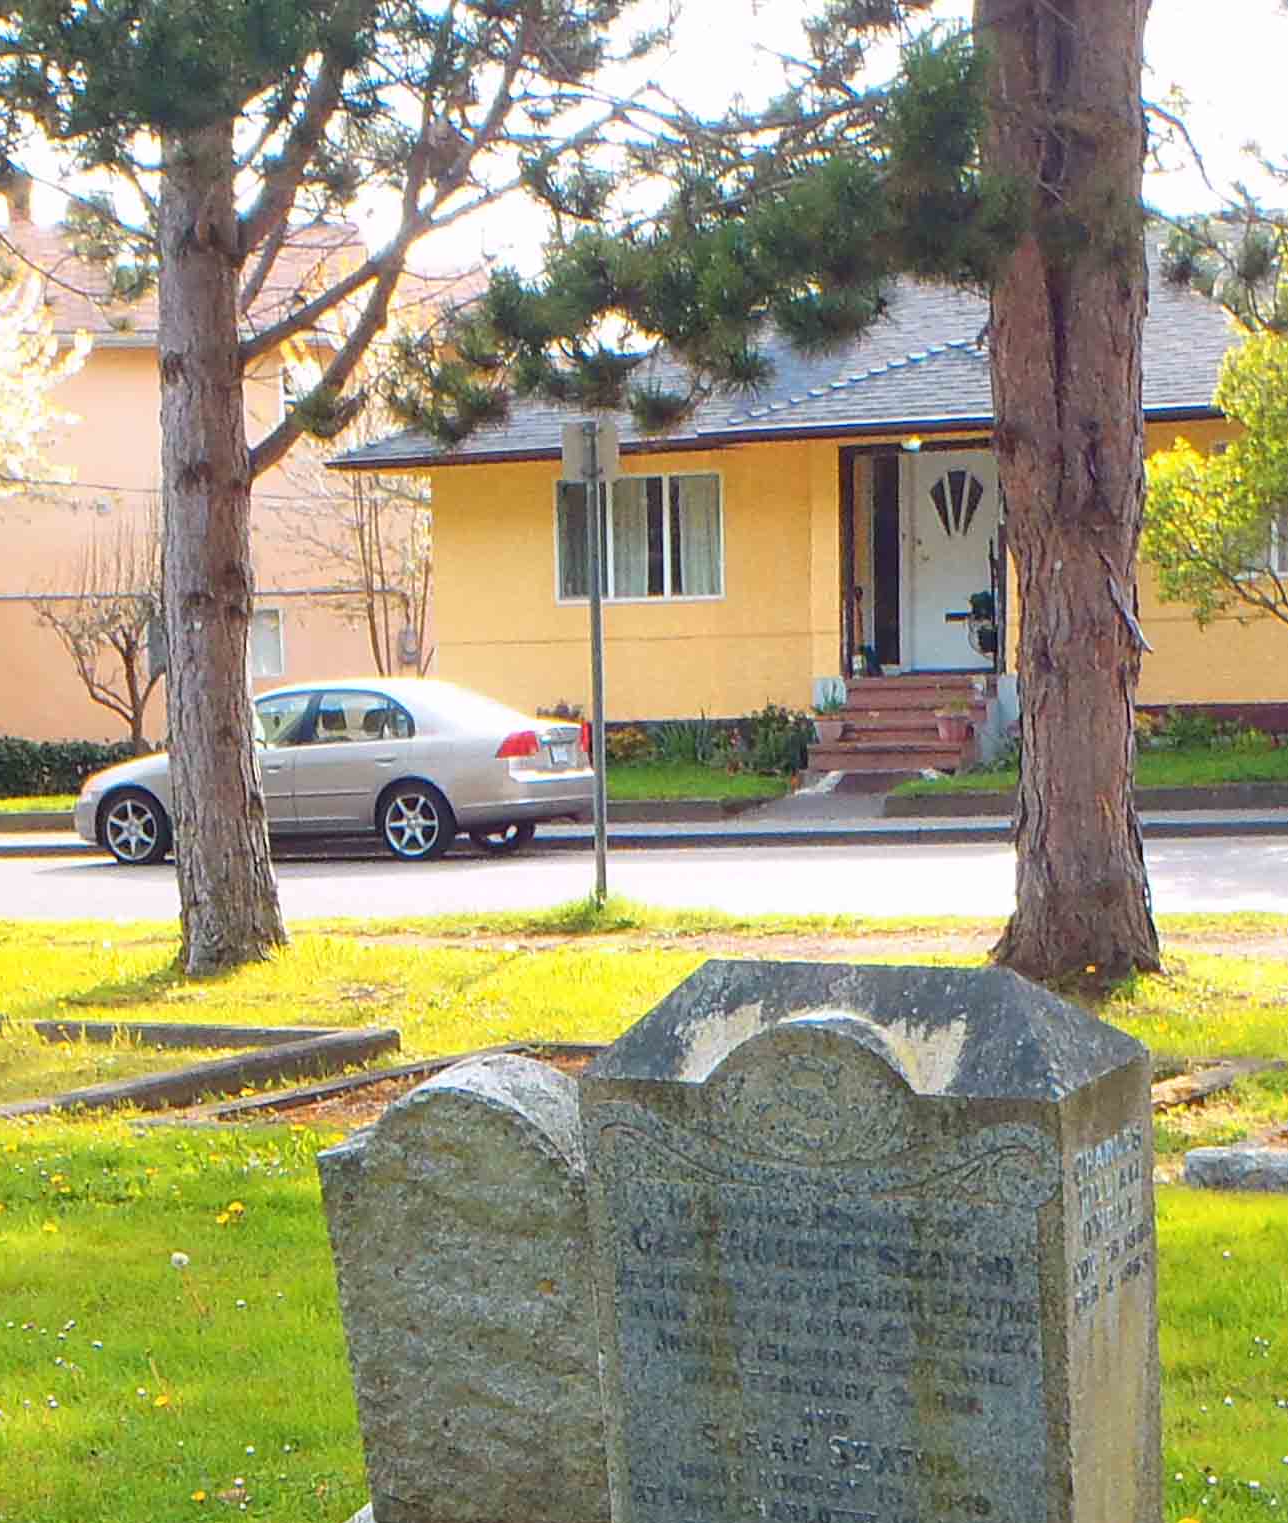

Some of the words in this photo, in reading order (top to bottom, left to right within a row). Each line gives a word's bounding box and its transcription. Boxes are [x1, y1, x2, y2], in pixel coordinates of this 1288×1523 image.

[700, 1421, 811, 1465] SARAH
[633, 1484, 662, 1504] AT
[757, 1467, 863, 1496] AUGUST
